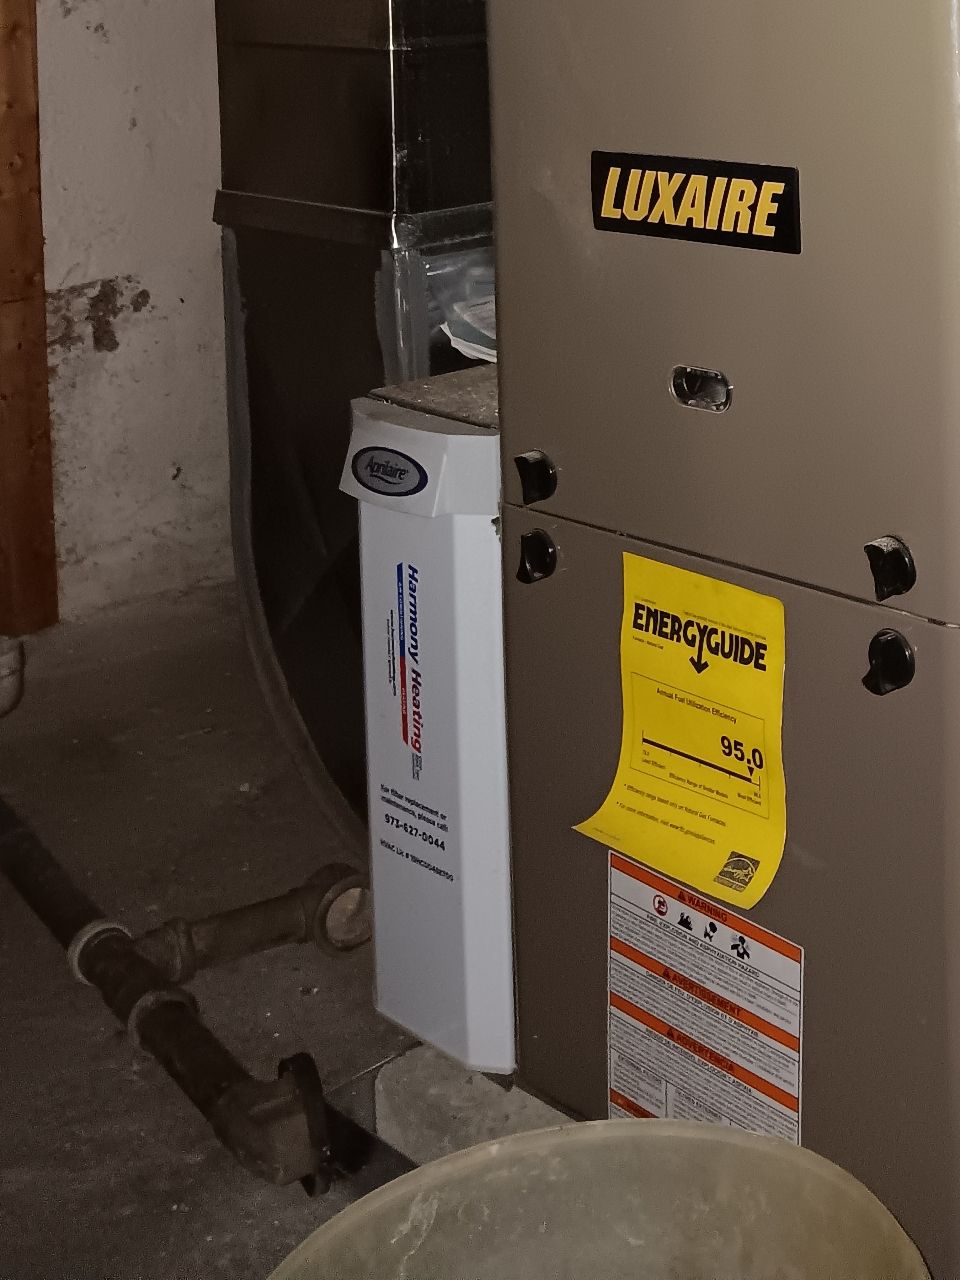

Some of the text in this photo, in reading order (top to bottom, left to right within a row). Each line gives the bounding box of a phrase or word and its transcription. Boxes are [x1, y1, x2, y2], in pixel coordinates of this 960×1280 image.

[601, 167, 785, 237] LUXAIRE
[408, 563, 419, 665] Harmony
[632, 602, 768, 672] ENERGYGUIDE
[411, 668, 424, 754] Heating
[656, 687, 737, 724] Annual Fuel Utilization Efficiency
[720, 735, 764, 770] 95.0
[385, 813, 446, 852] 973-627-0044
[687, 895, 728, 923] WARNING
